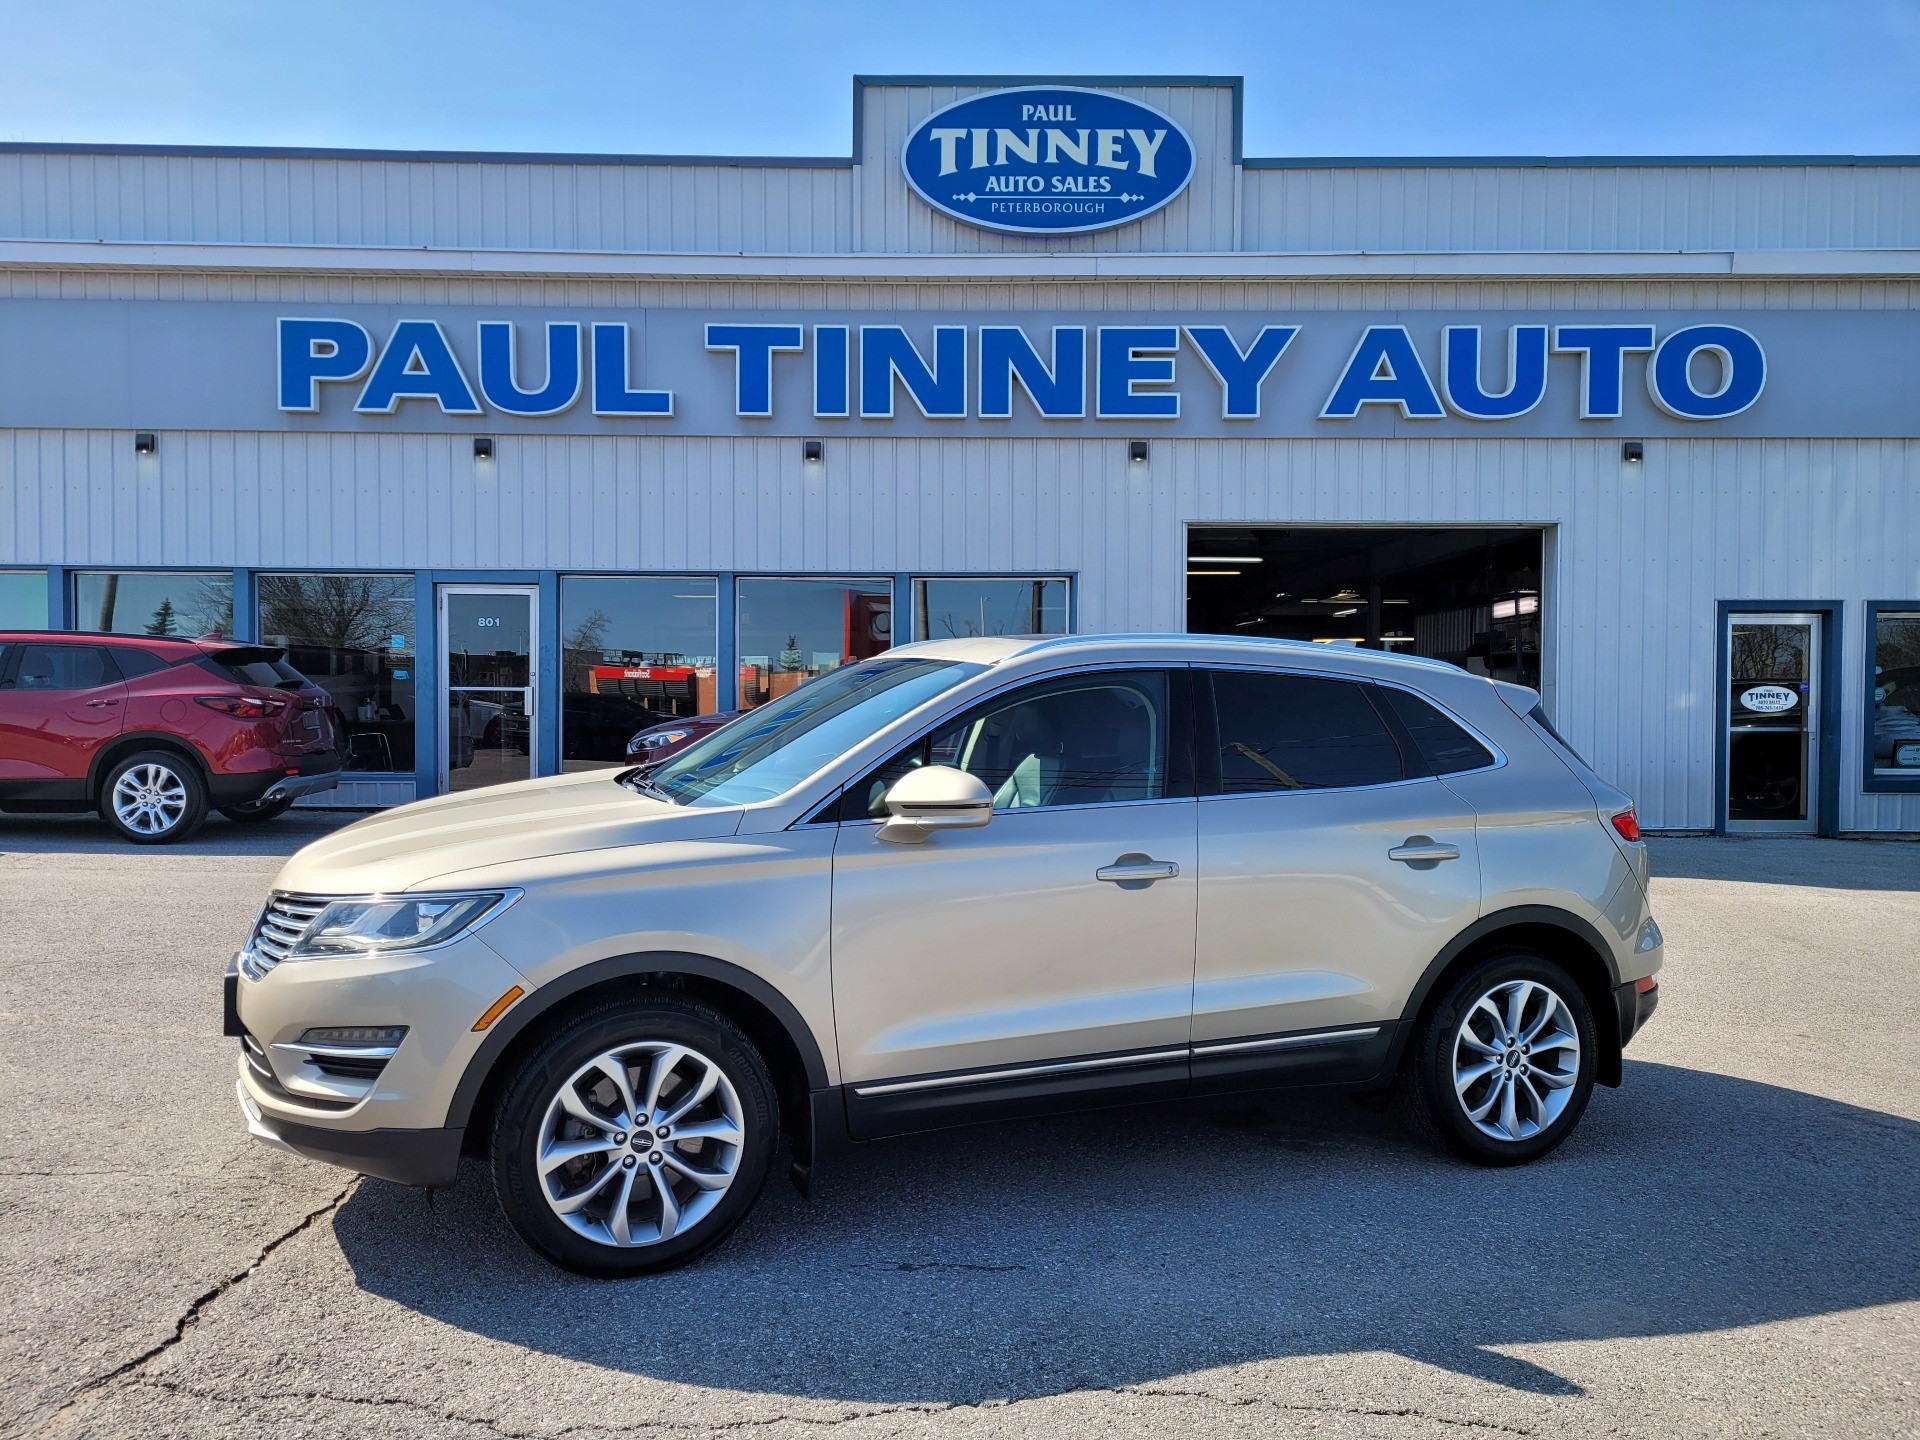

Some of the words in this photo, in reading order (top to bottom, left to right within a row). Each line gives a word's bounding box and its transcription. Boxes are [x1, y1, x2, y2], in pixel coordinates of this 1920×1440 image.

[1022, 104, 1077, 121] PAUL
[929, 128, 1168, 179] TINNEY
[985, 176, 1045, 193] AUTO
[1051, 176, 1112, 193] SALES
[991, 202, 1105, 214] PETERBOROUGH
[276, 316, 675, 418] PAUL
[704, 323, 1303, 420] TINNEY
[1317, 323, 1768, 421] AUTO
[477, 617, 501, 627] 801
[1748, 693, 1790, 701] TINNEY
